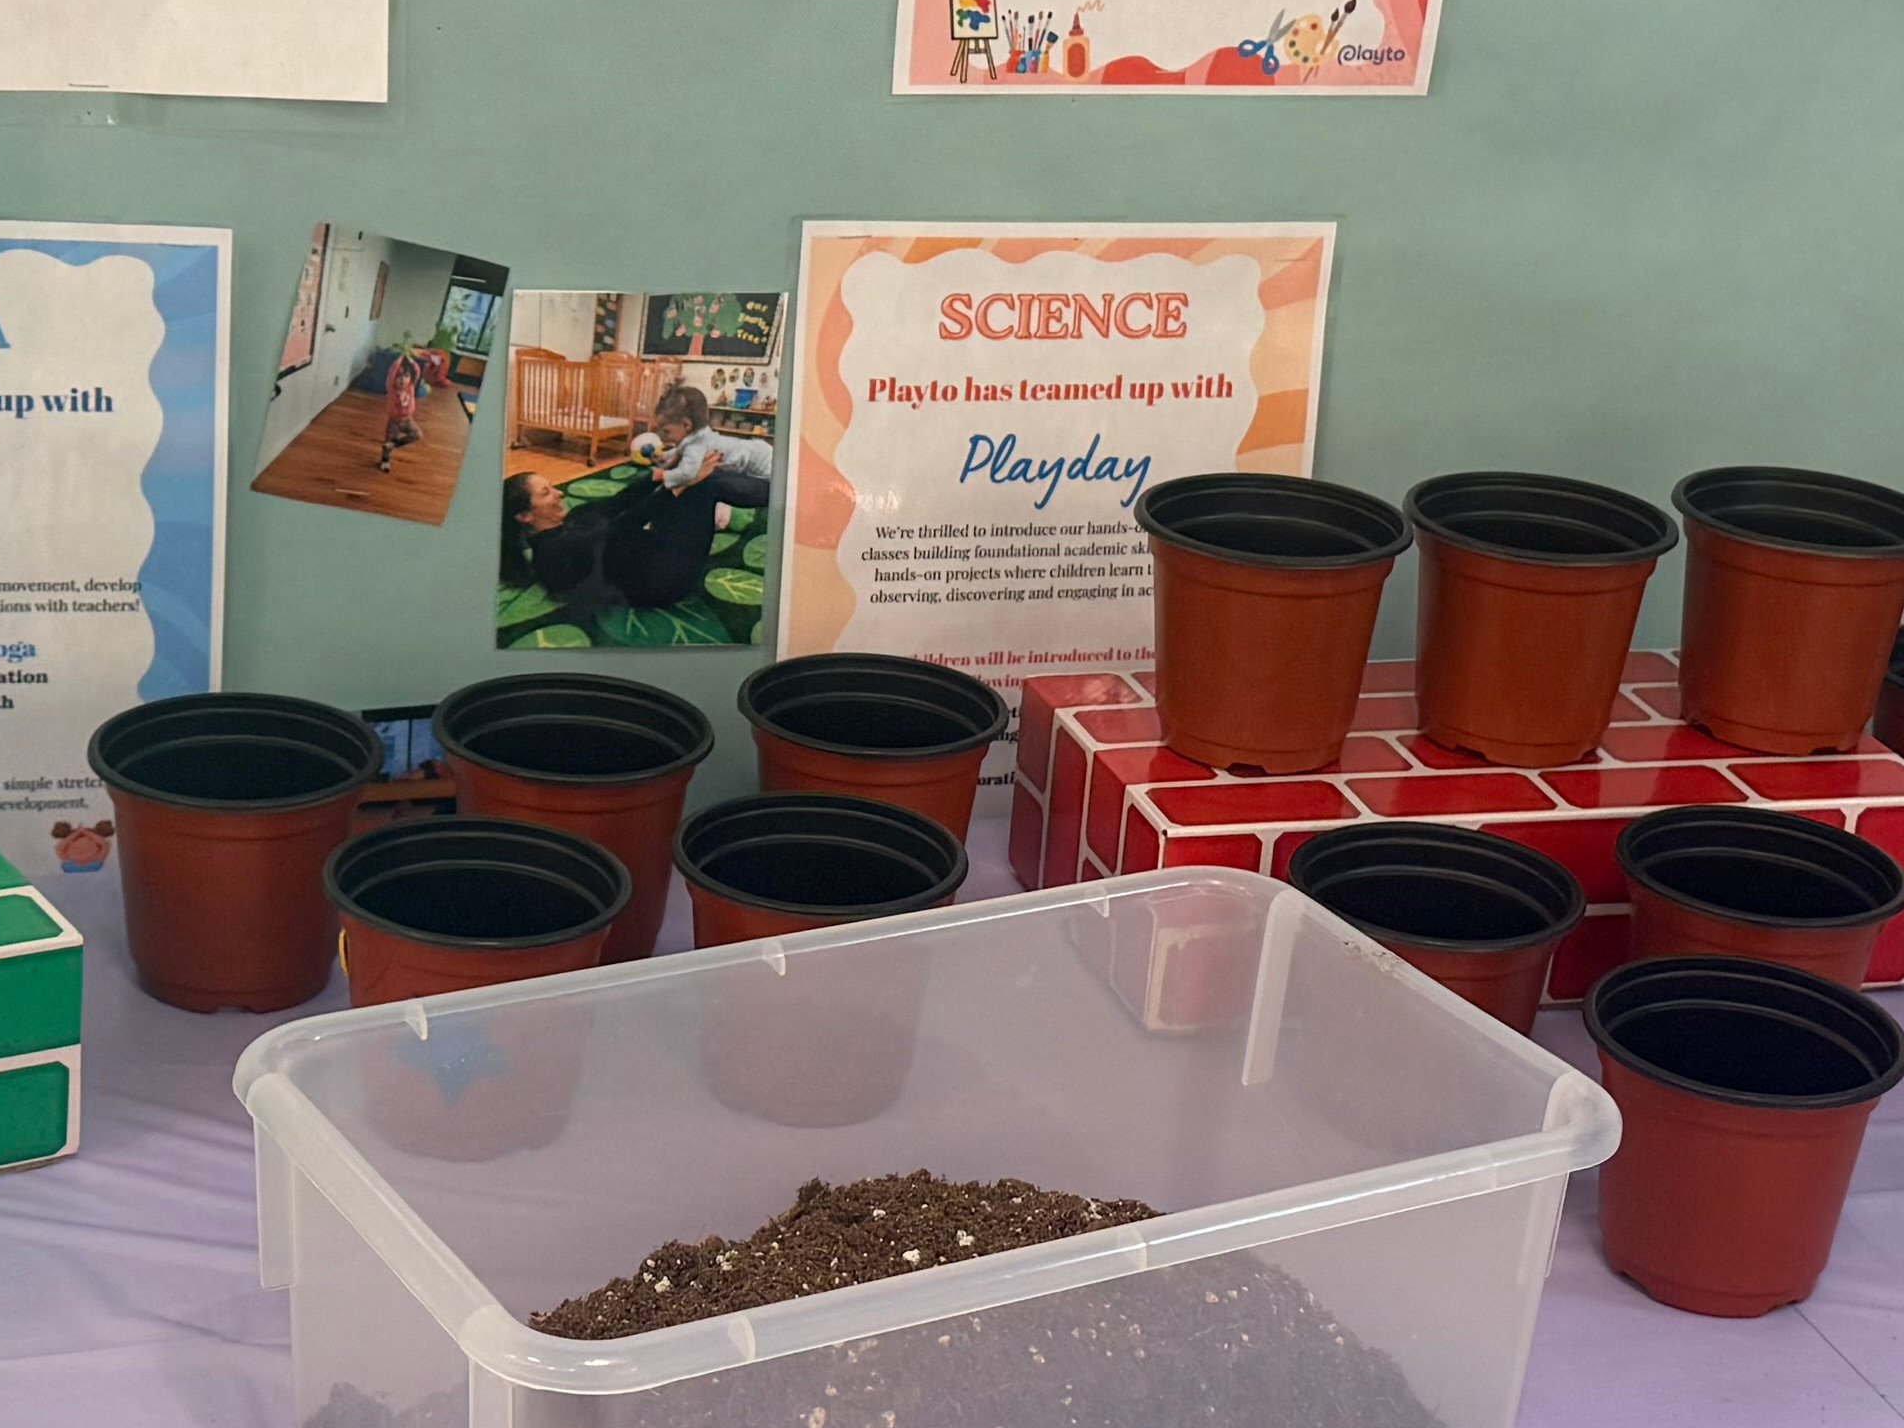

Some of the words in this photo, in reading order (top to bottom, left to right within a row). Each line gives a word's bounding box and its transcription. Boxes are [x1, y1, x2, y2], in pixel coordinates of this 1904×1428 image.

[1337, 43, 1406, 66] Playto
[938, 292, 1190, 341] SCIENCE
[41, 386, 113, 413] with
[868, 376, 959, 410] Playto
[964, 376, 1013, 402] has
[1019, 374, 1123, 402] teamed
[1129, 382, 1165, 407] up
[1171, 373, 1233, 399] with
[959, 433, 1152, 511] Playday
[874, 567, 942, 583] hands-on
[945, 566, 1001, 584] projects
[1003, 565, 1047, 580] where
[1049, 563, 1106, 579] children
[1109, 562, 1146, 577] learn
[34, 598, 69, 613] with
[71, 598, 140, 613] teachers!
